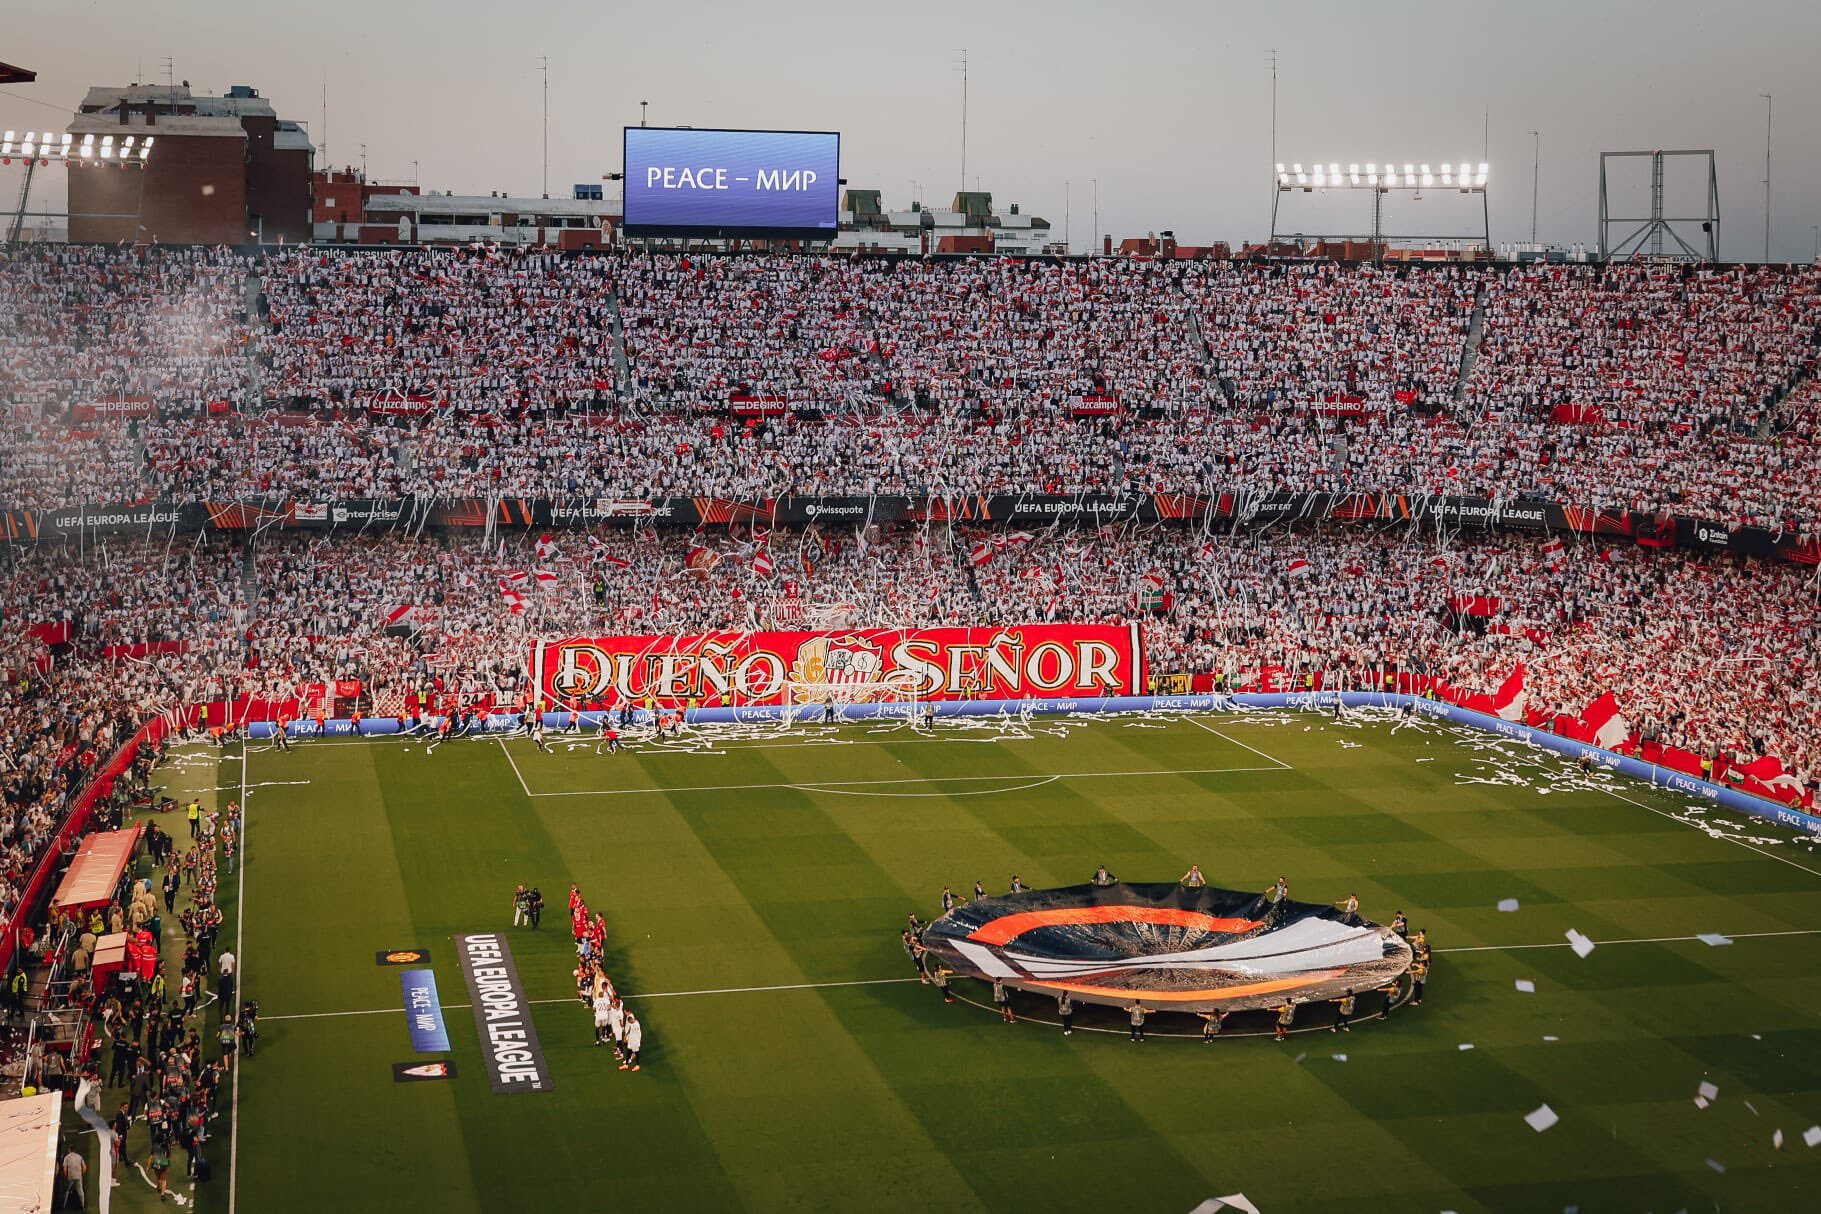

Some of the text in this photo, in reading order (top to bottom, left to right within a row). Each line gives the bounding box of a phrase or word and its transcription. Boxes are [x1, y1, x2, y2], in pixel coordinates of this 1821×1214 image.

[647, 167, 729, 190] PEACE
[756, 169, 817, 191] МИР
[107, 401, 150, 413] DEGIRO
[746, 401, 785, 411] DEGIRO
[1323, 402, 1362, 411] DEGIRO
[551, 508, 581, 518] UEFA
[816, 504, 864, 516] Swissquote
[1015, 502, 1128, 513] UEFA EUROPA LEAGUE
[1278, 503, 1292, 511] EAT
[1430, 505, 1458, 516] UEFA
[1503, 508, 1543, 521] LEAGUE
[56, 512, 179, 528] UEFA EUROPA LEAGUE
[553, 631, 1121, 699] DUEÑO SEÑOR
[462, 694, 479, 706] 24
[1056, 701, 1078, 711] МИР
[1155, 700, 1183, 708] PEACE
[1190, 699, 1211, 707] МИР
[741, 709, 770, 719] PEACE
[1675, 777, 1697, 792] PEACE
[1702, 787, 1719, 798] МИР
[1777, 810, 1800, 827] PEACE
[464, 933, 504, 967] UEFA
[411, 986, 432, 1009] PEACE
[473, 966, 520, 1021] EUROPA
